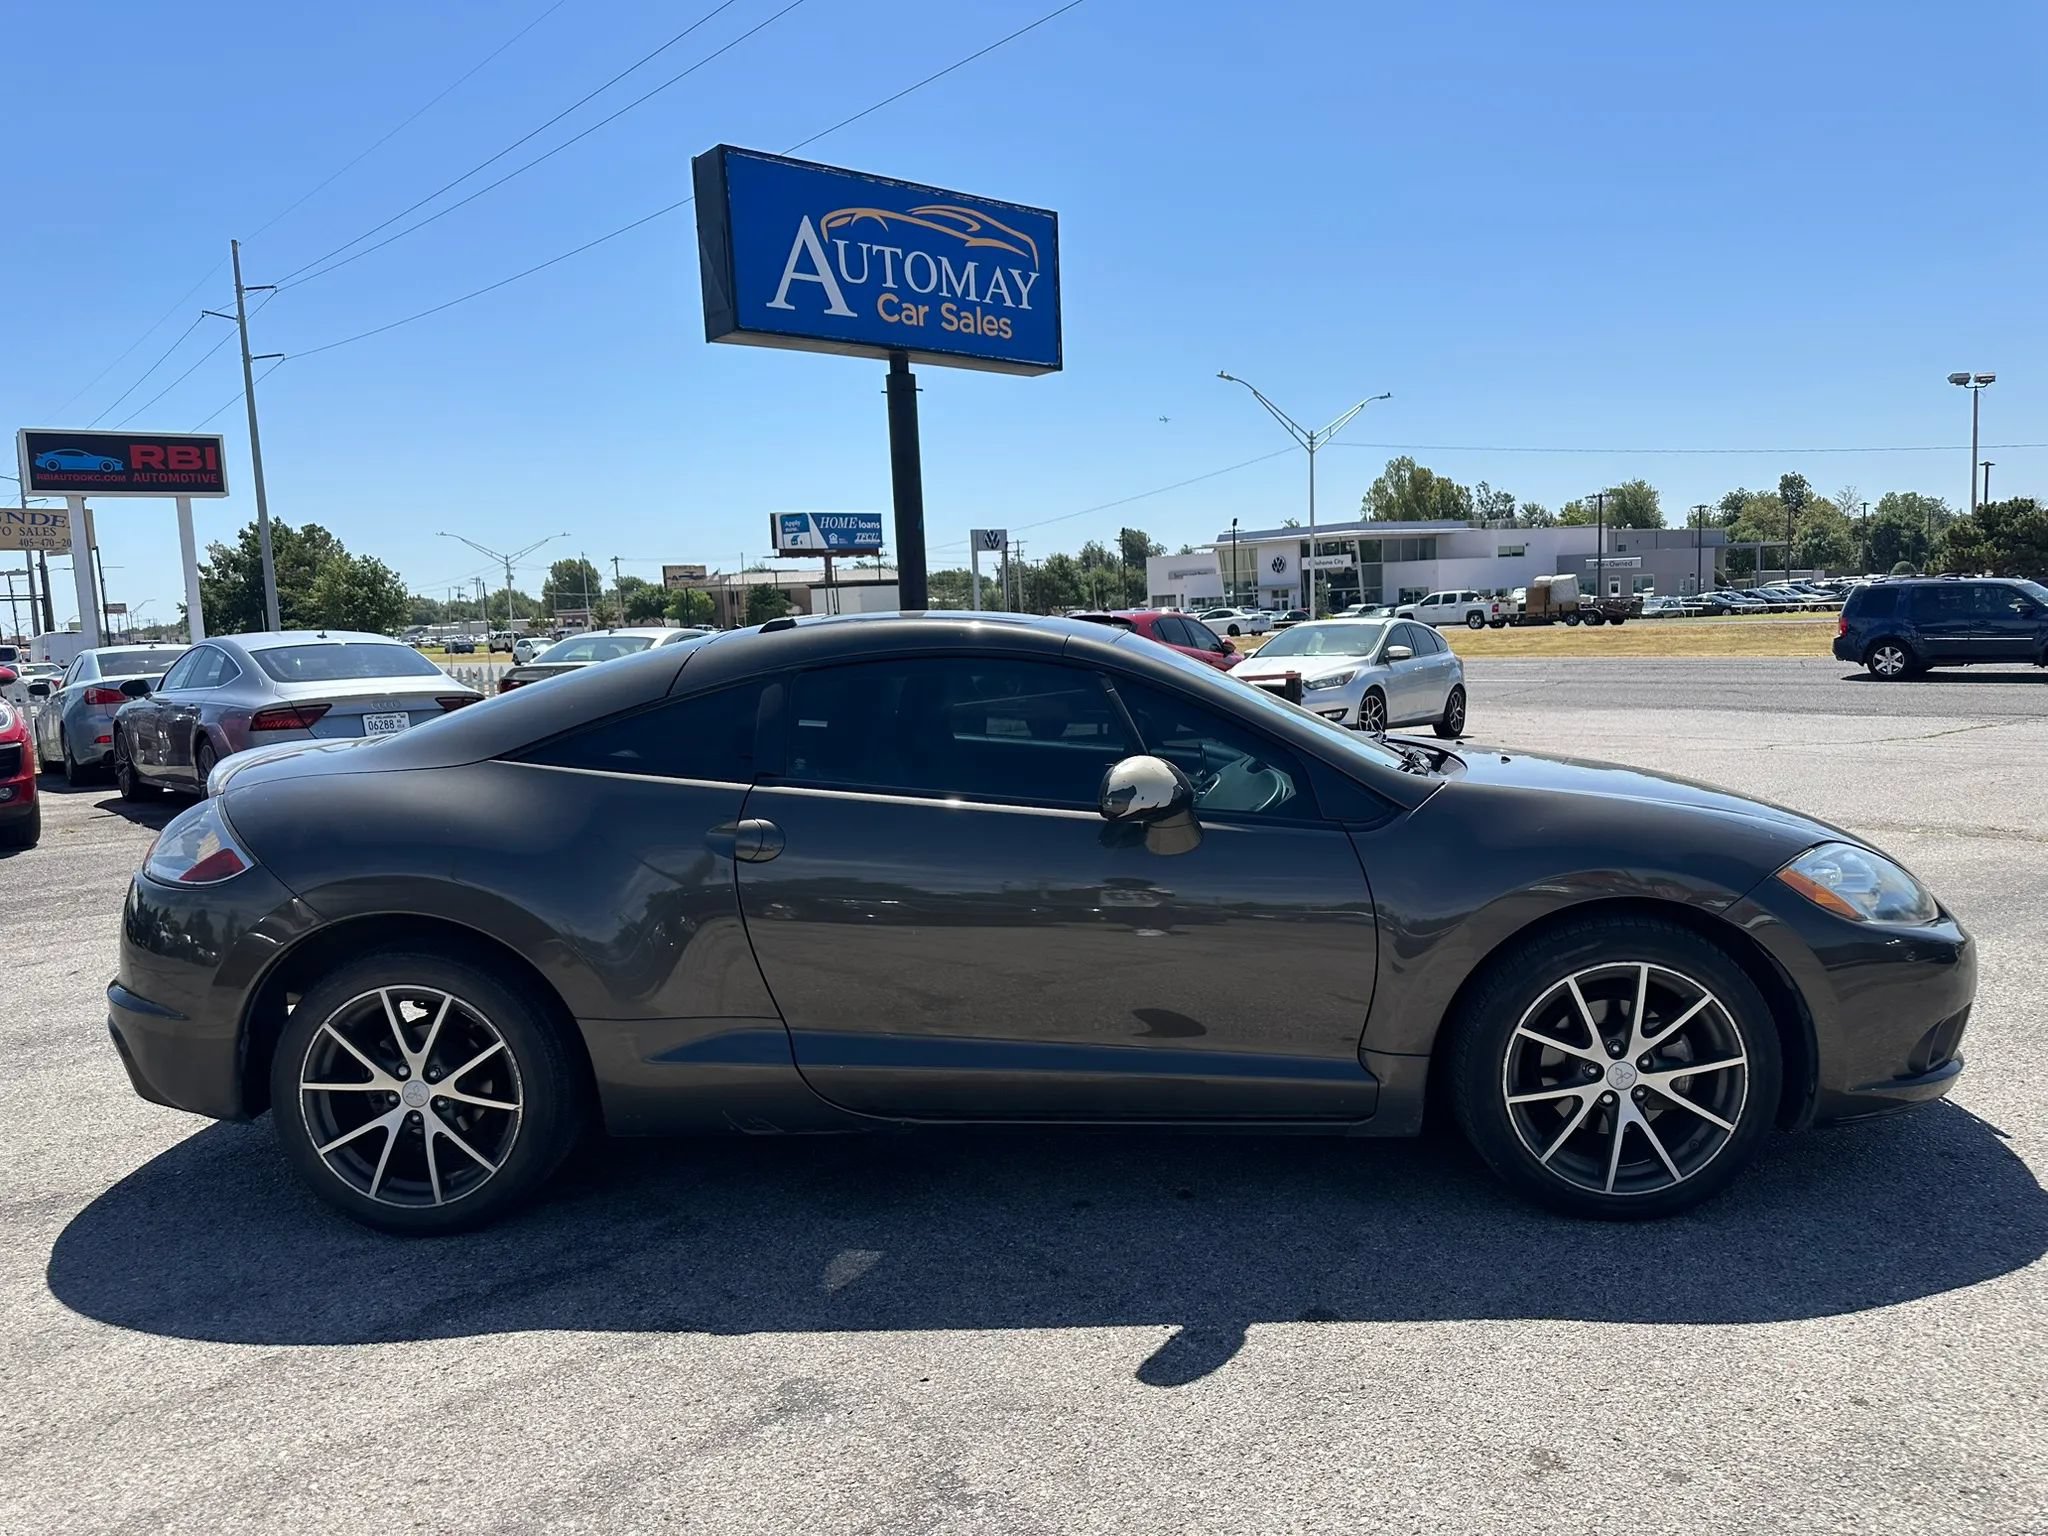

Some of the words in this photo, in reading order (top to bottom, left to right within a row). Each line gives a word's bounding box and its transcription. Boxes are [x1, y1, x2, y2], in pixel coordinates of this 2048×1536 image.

[766, 215, 1040, 317] AUTOMAY
[876, 293, 929, 327] Car
[941, 302, 1013, 340] Sales
[129, 444, 217, 470] RBI
[36, 473, 127, 482] RBIAUTOOKC.COM
[133, 472, 219, 484] AUTOMOTIVE
[0, 511, 70, 528] NDE
[820, 516, 858, 529] HOME
[858, 519, 880, 529] loans
[19, 526, 57, 537] SALES
[368, 719, 395, 731] 06288
